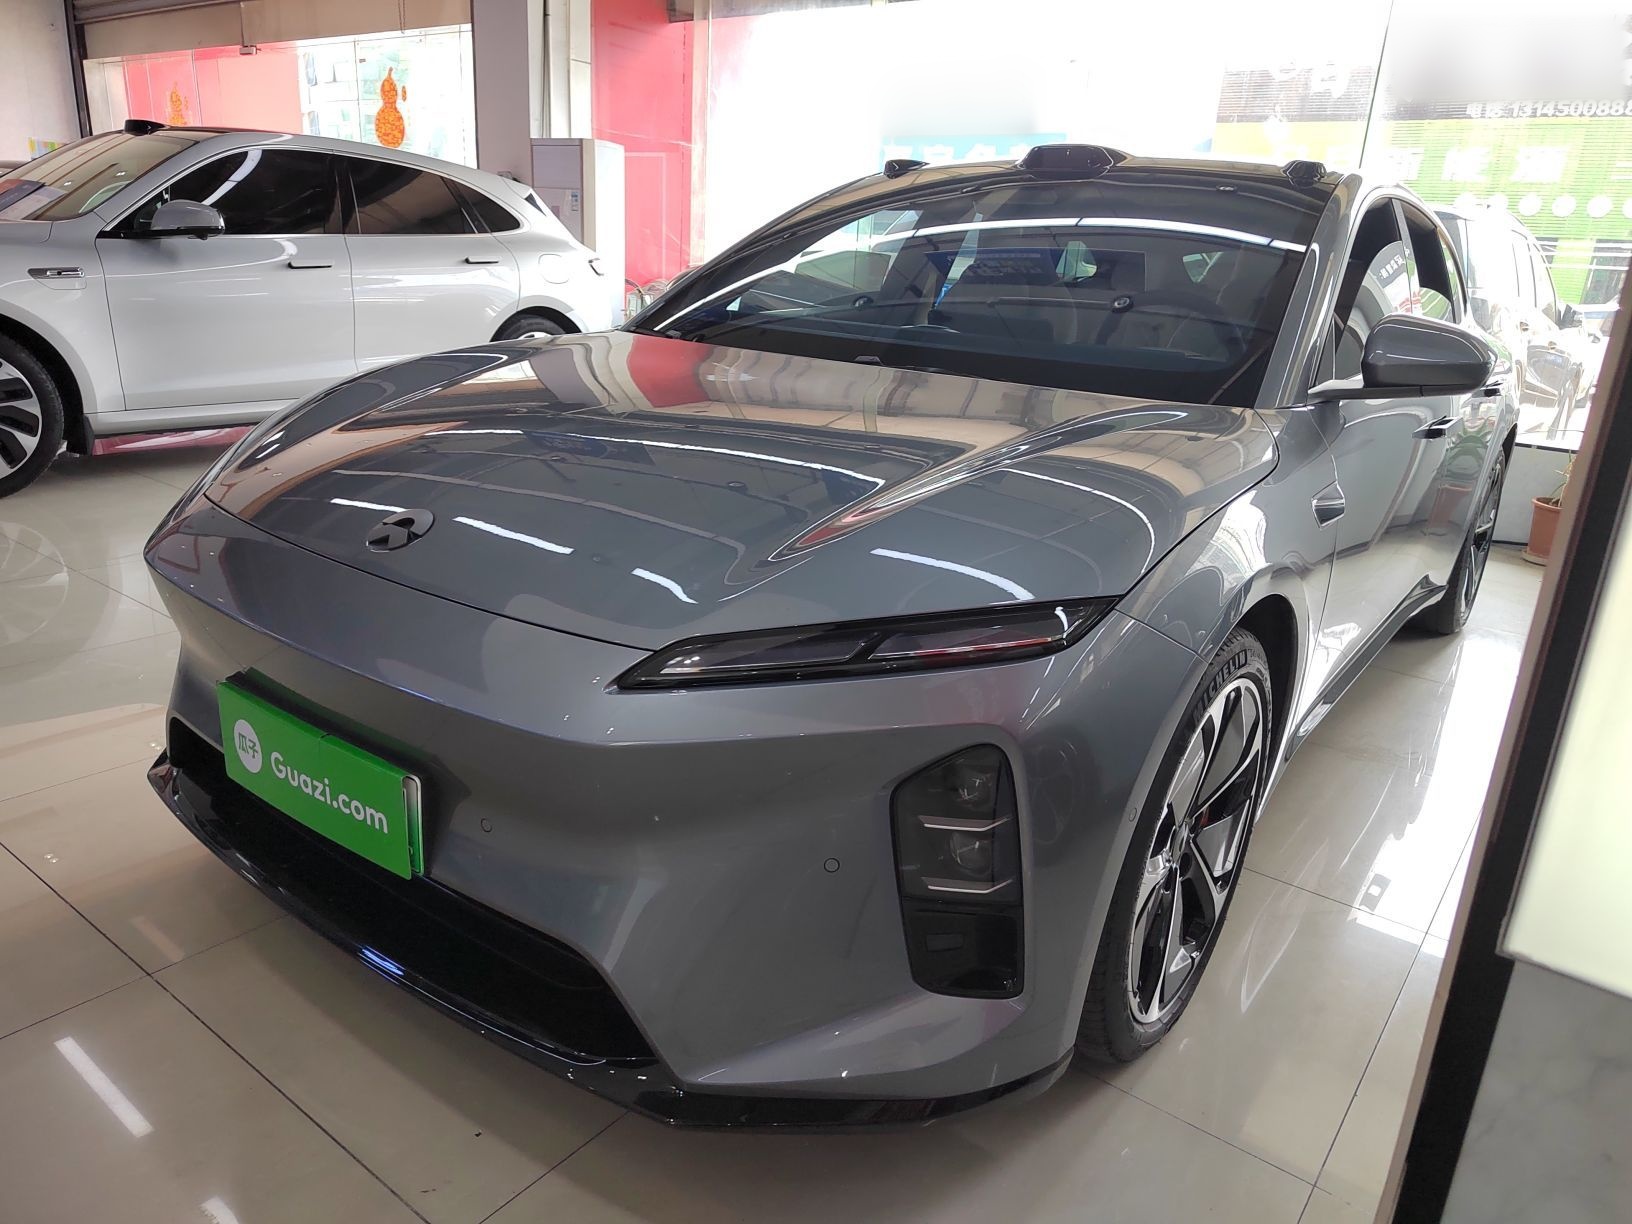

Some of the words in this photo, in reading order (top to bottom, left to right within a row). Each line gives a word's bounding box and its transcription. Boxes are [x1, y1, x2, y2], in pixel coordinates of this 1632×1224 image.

[1193, 650, 1247, 725] MICHELIN
[238, 731, 259, 759] 瓜子
[270, 751, 388, 834] Guazi.com
